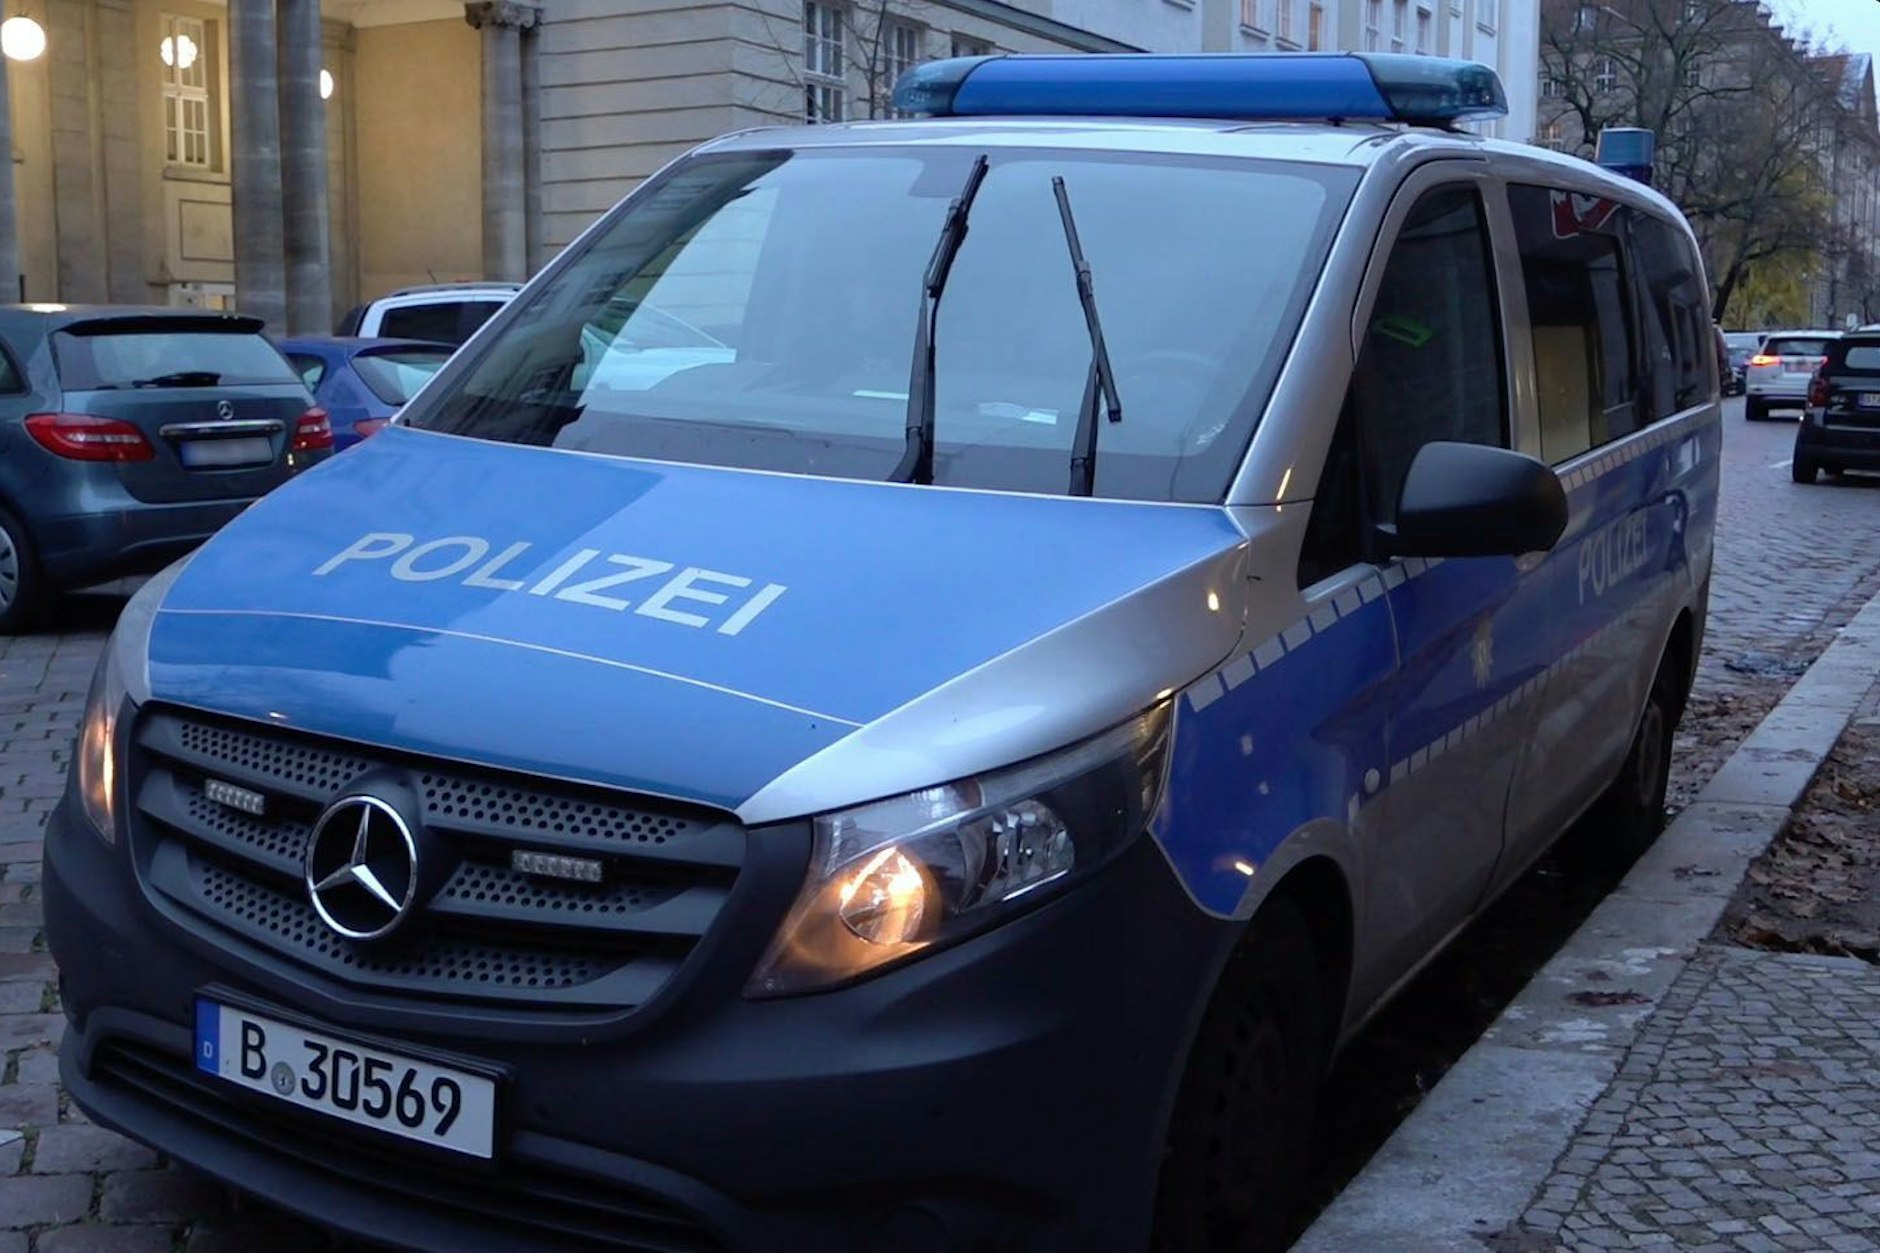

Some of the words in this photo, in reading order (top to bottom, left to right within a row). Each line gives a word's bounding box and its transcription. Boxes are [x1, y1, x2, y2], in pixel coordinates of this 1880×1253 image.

[312, 532, 788, 636] POLIZEI
[1578, 512, 1648, 606] POLIZEI
[203, 1041, 213, 1058] D
[241, 1020, 267, 1080] B
[301, 1039, 462, 1136] 30569
